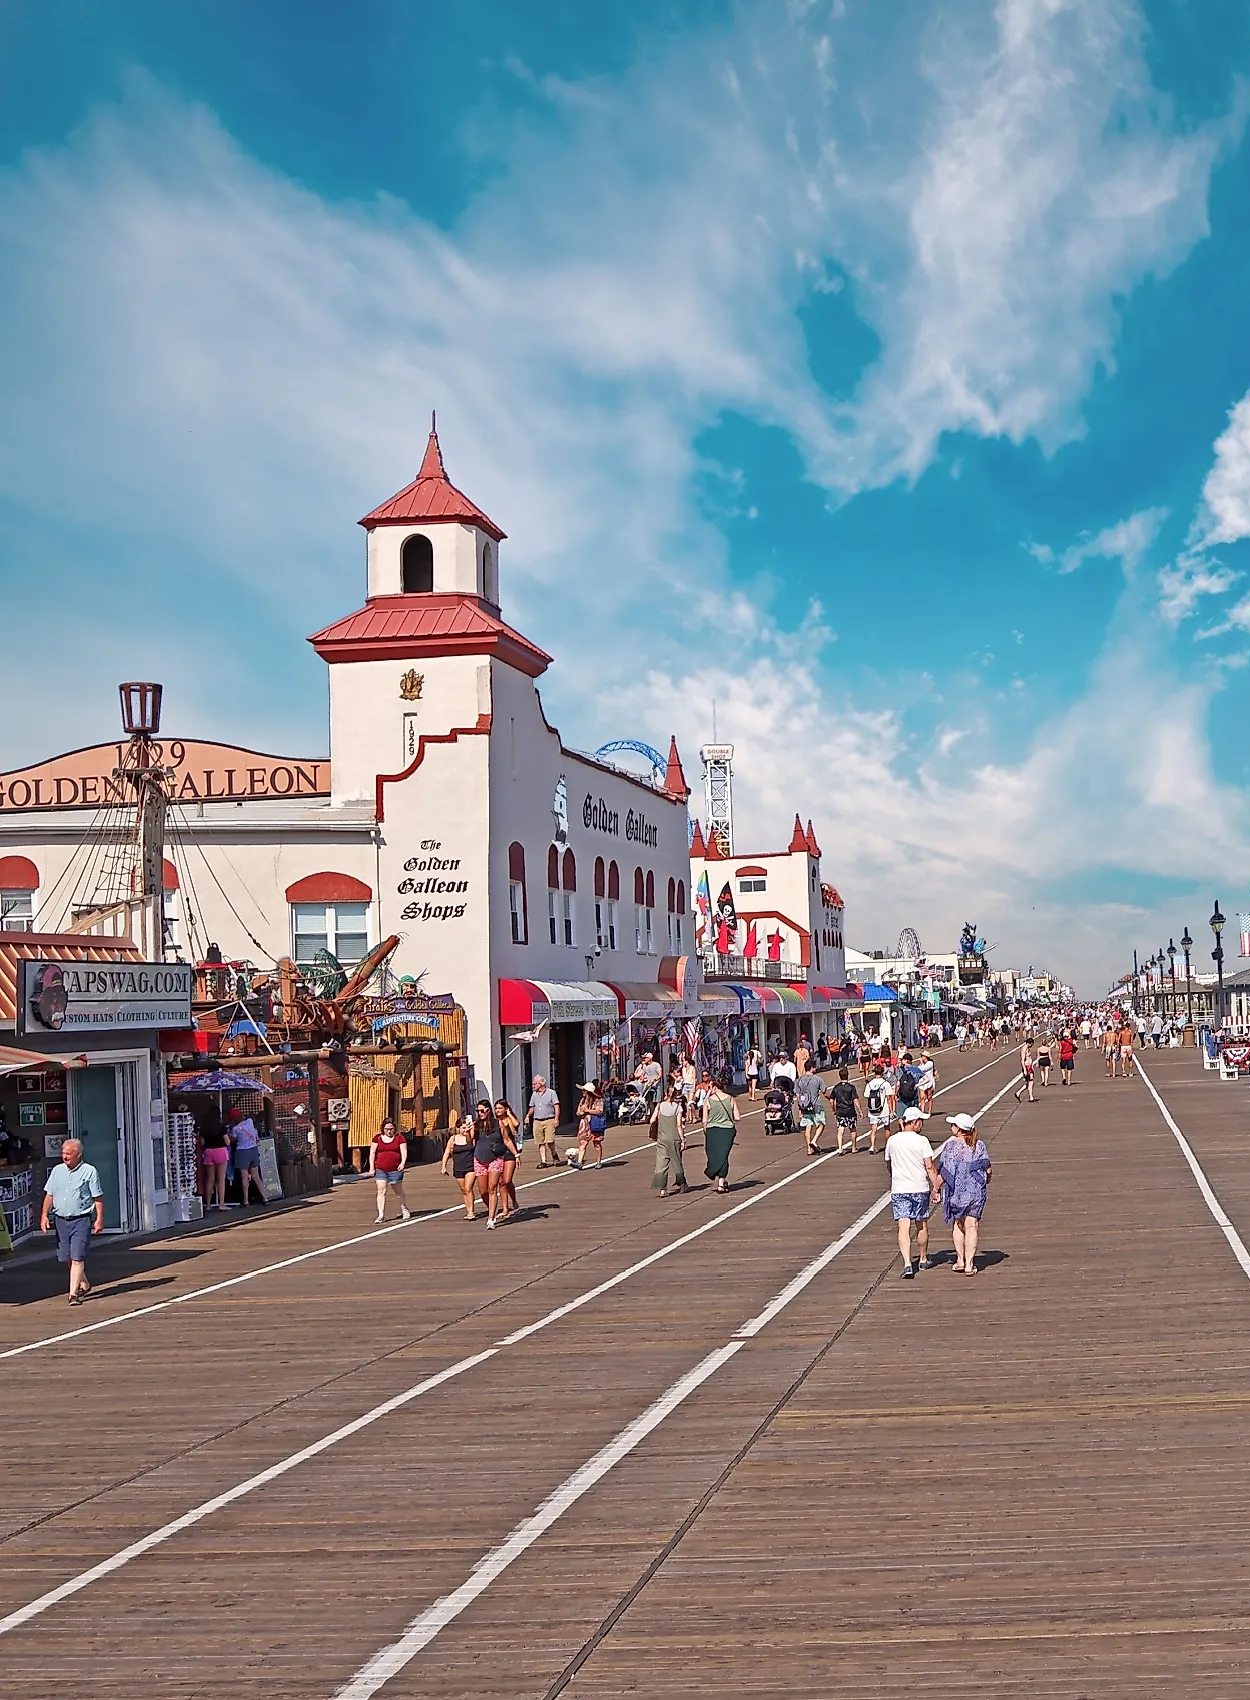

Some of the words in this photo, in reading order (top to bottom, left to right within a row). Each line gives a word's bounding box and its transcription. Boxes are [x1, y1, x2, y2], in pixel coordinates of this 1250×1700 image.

[582, 792, 618, 836] Golden
[625, 807, 658, 849] Galleon
[420, 839, 442, 851] The
[403, 857, 461, 871] Golden
[397, 877, 469, 894] Galleon
[400, 901, 467, 921] Shops
[93, 1013, 114, 1023] HATS
[383, 1015, 414, 1026] ADVENTURE
